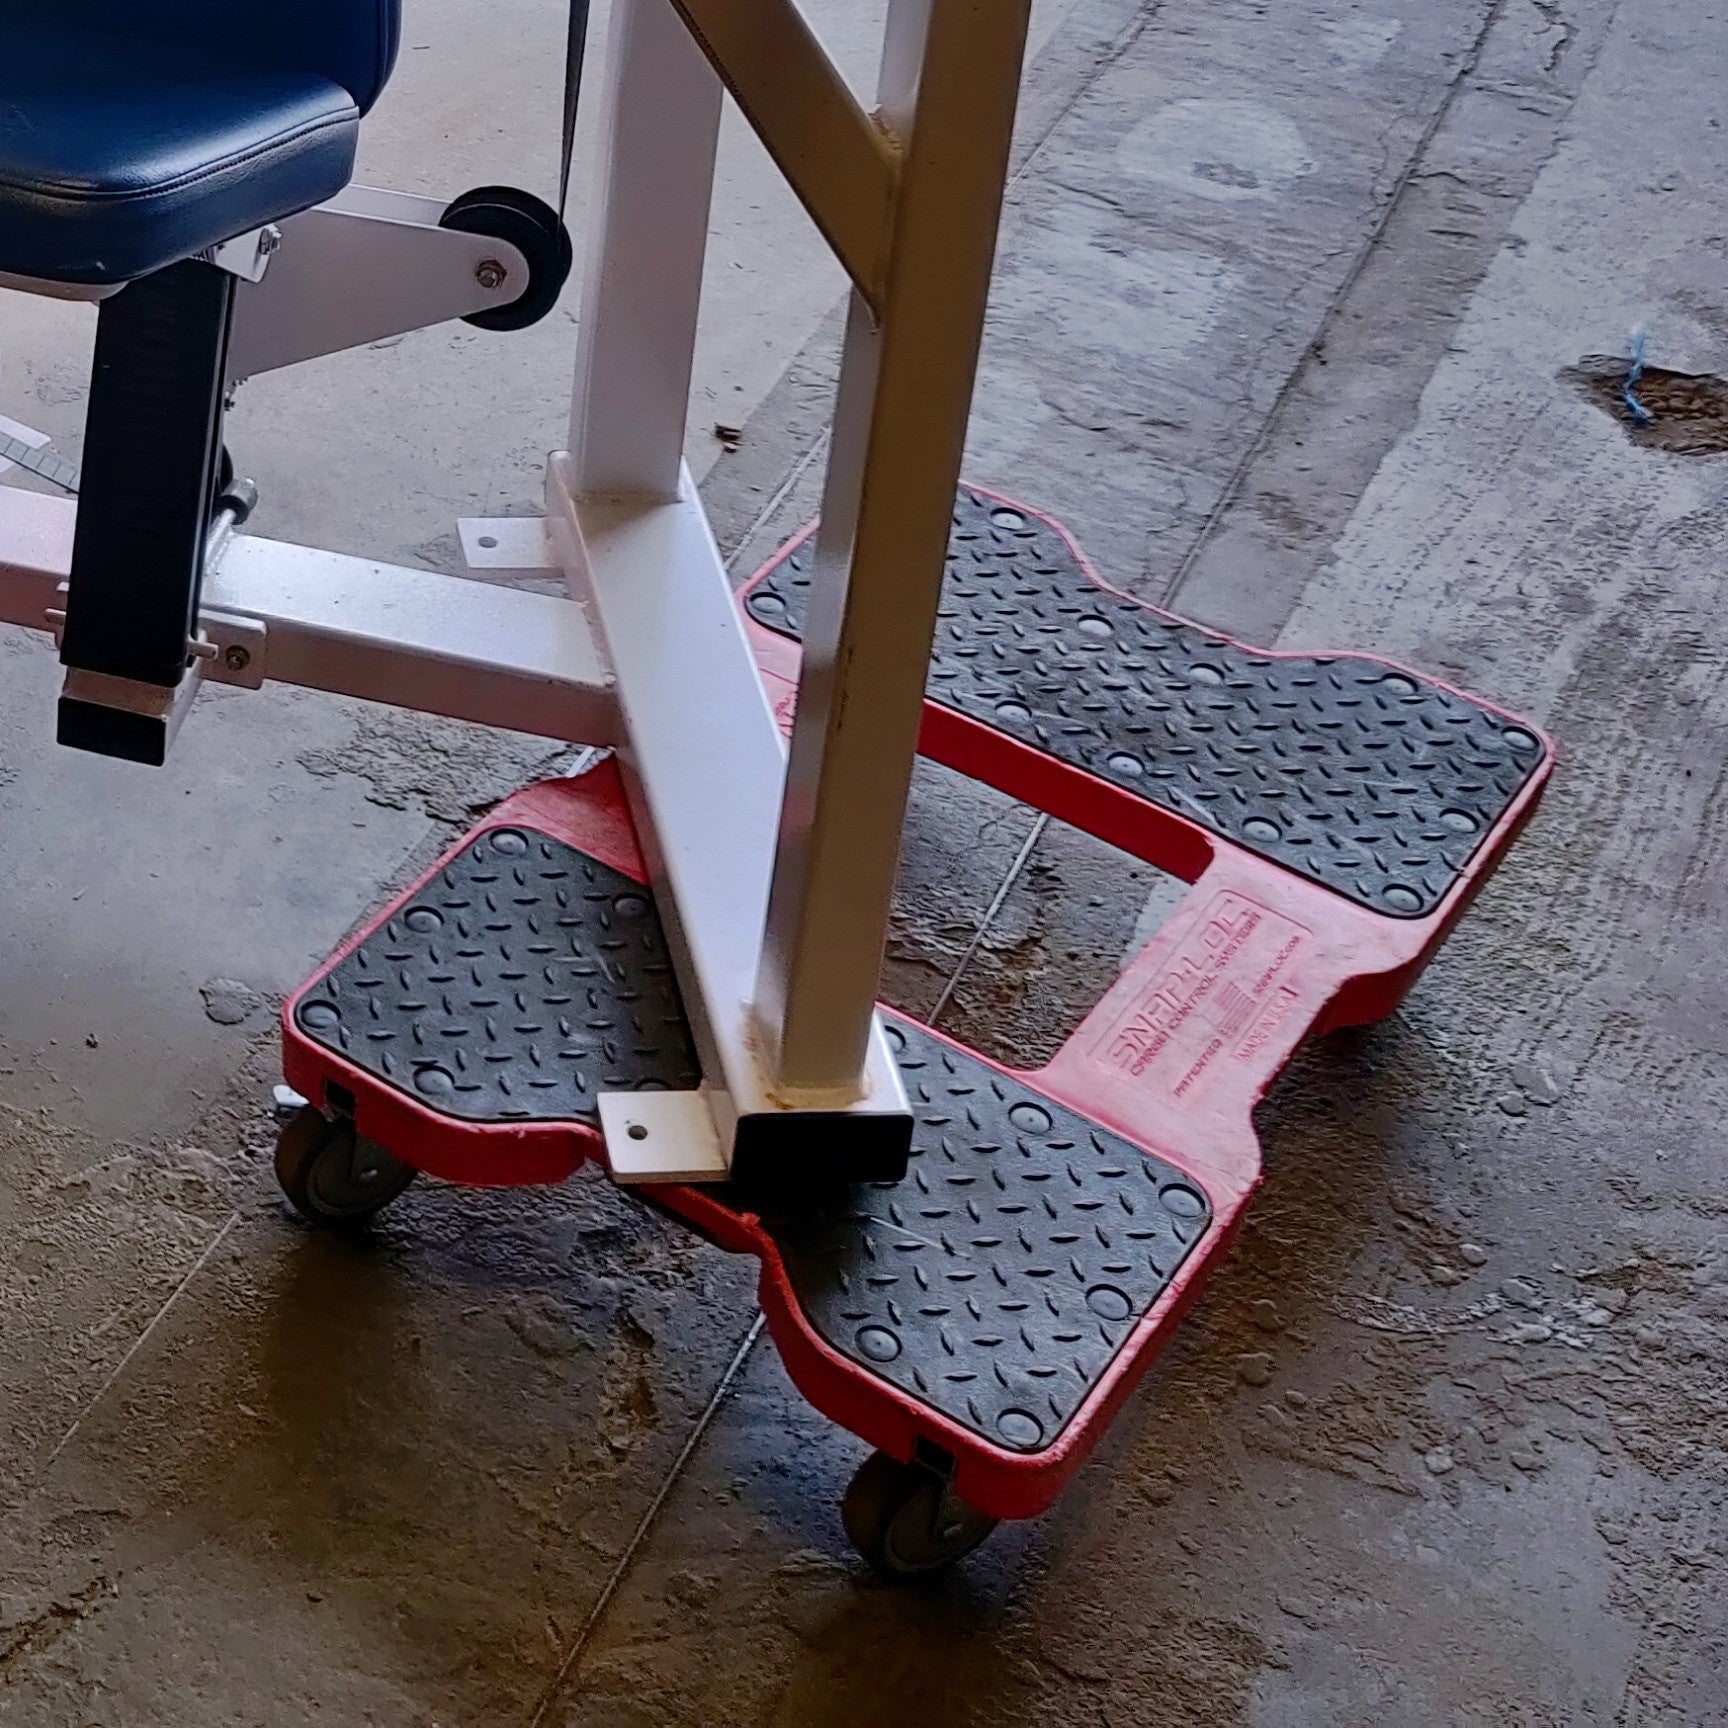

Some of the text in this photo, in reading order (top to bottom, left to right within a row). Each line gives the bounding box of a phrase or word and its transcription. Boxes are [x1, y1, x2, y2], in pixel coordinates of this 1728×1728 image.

[1130, 910, 1262, 1077] CARGO CONTROL SYSTEMS
[1173, 1038, 1223, 1097] PATENTED
